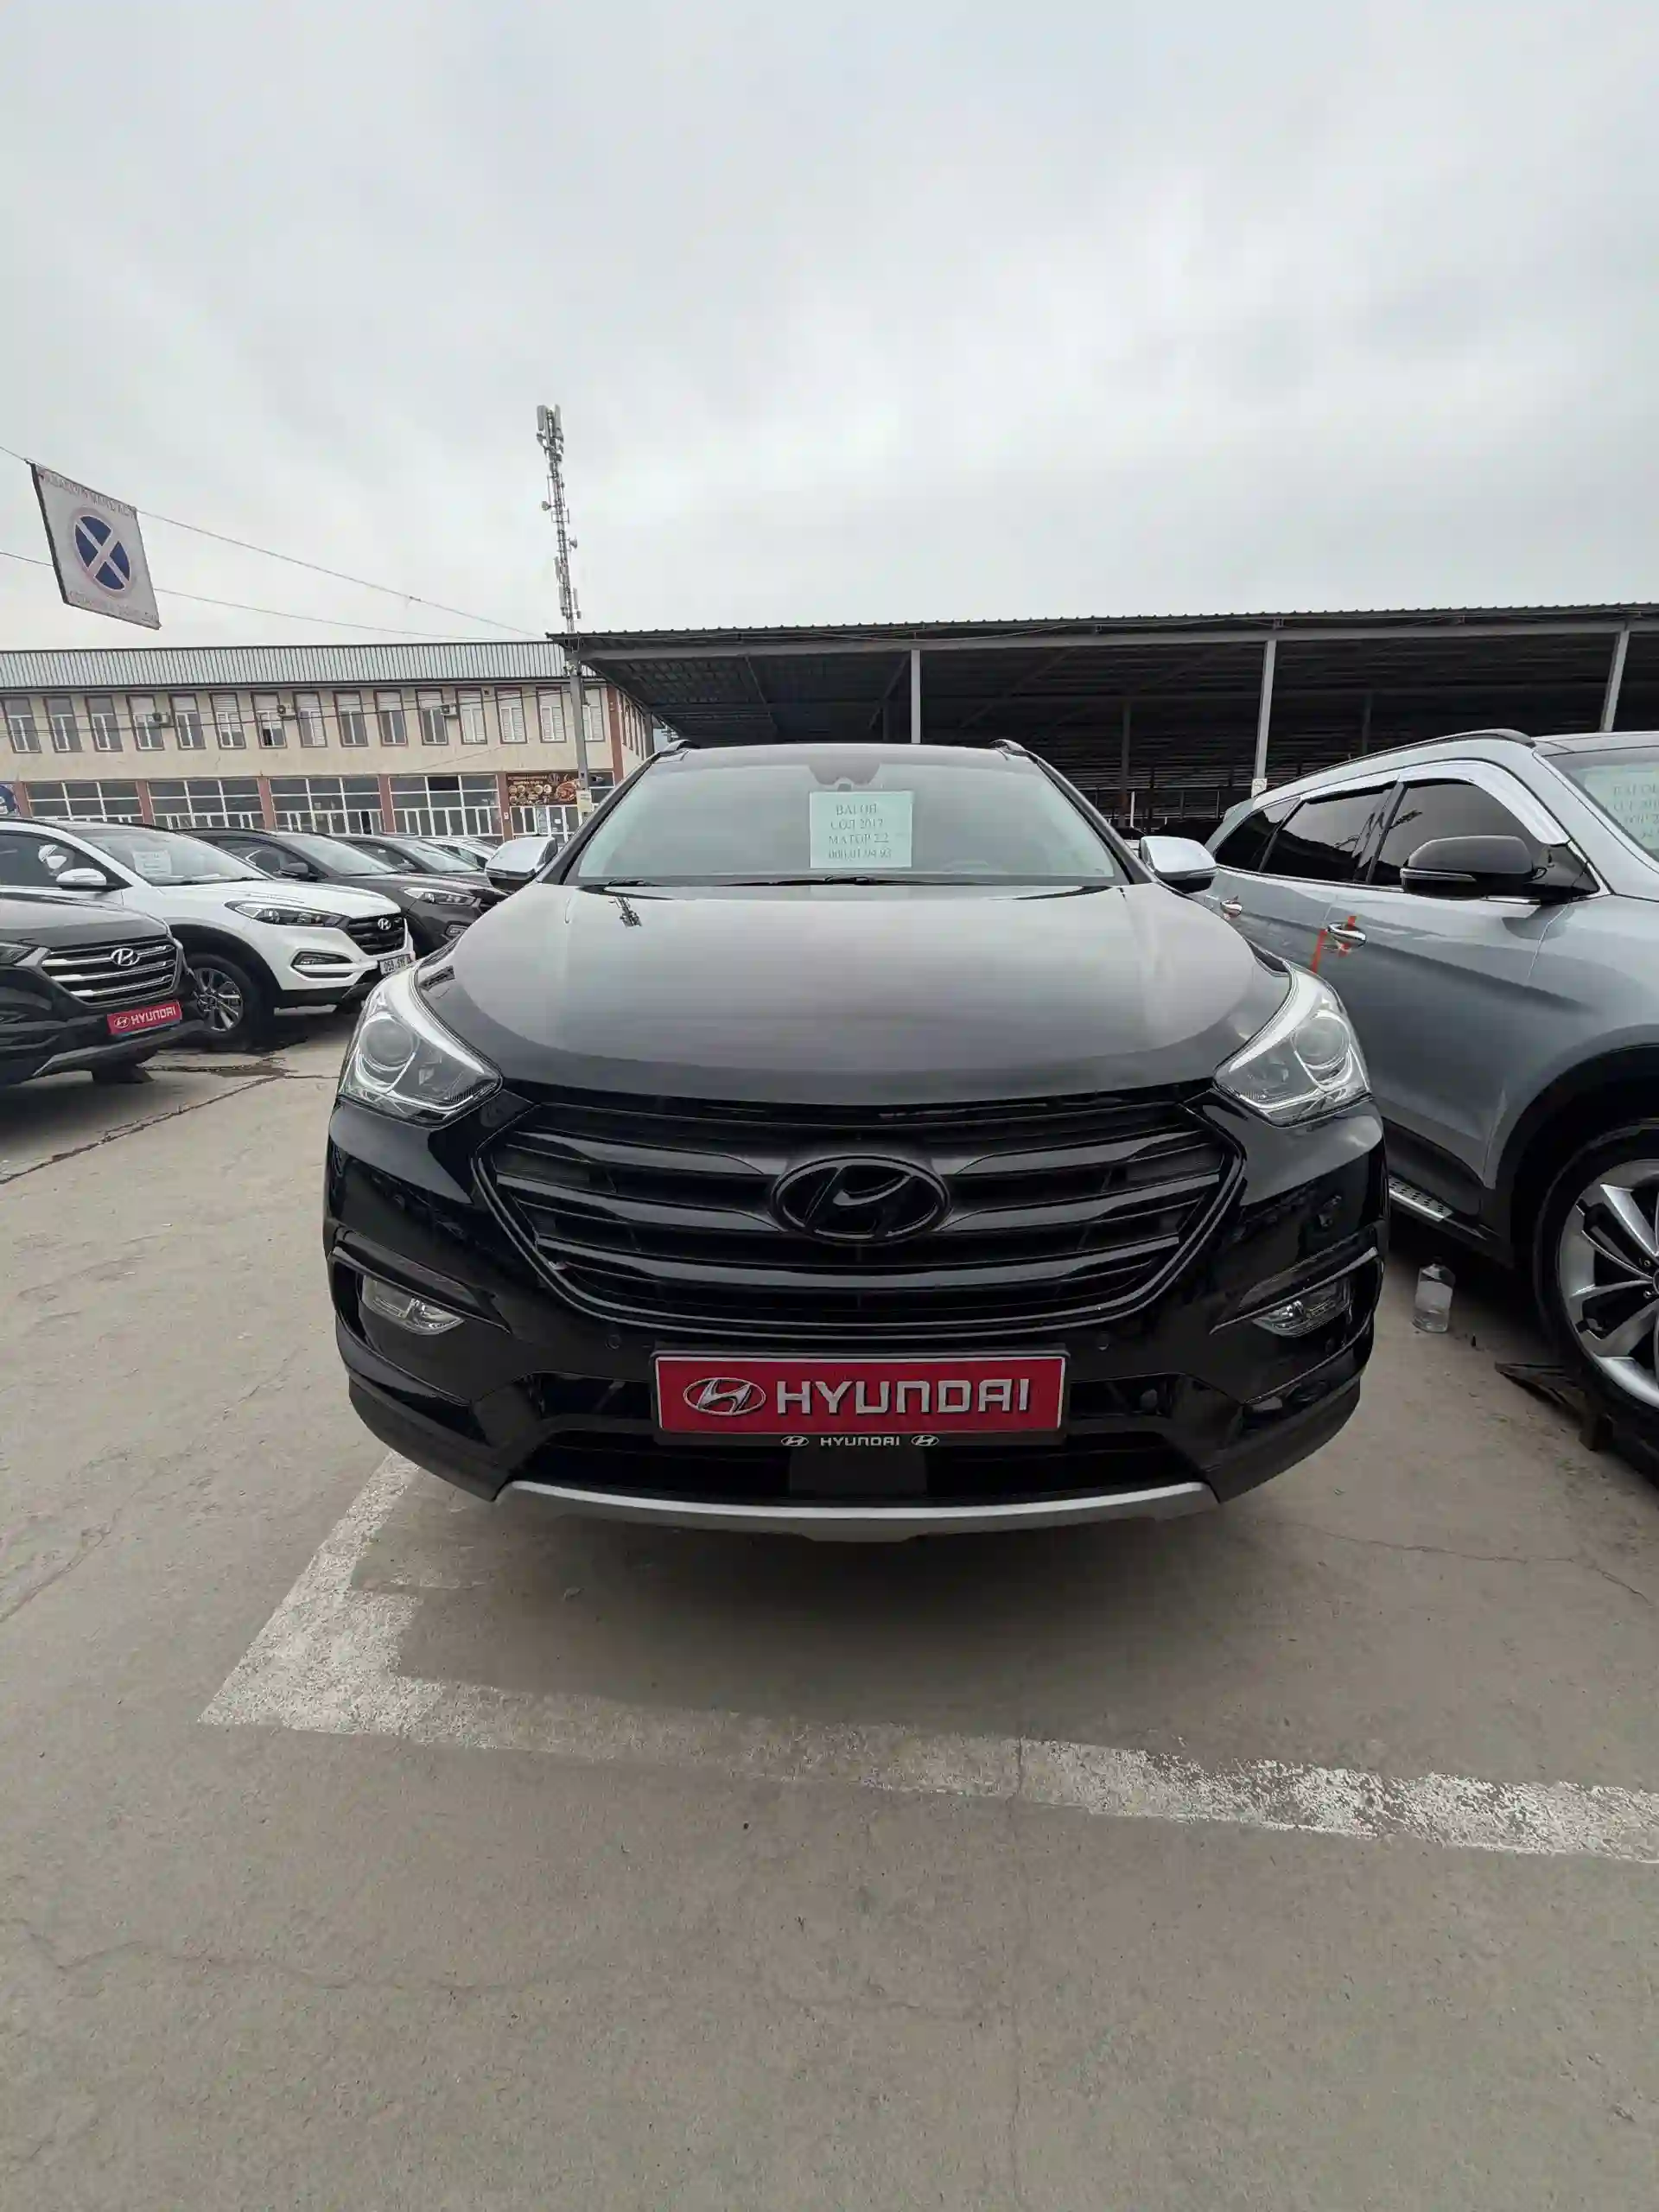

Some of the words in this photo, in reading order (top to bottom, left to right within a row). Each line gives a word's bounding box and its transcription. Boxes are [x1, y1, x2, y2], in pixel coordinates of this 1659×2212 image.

[130, 1005, 177, 1025] HYUNDAI
[777, 1378, 1030, 1414] HYUNDAI
[820, 1436, 900, 1446] HYUNDAI
